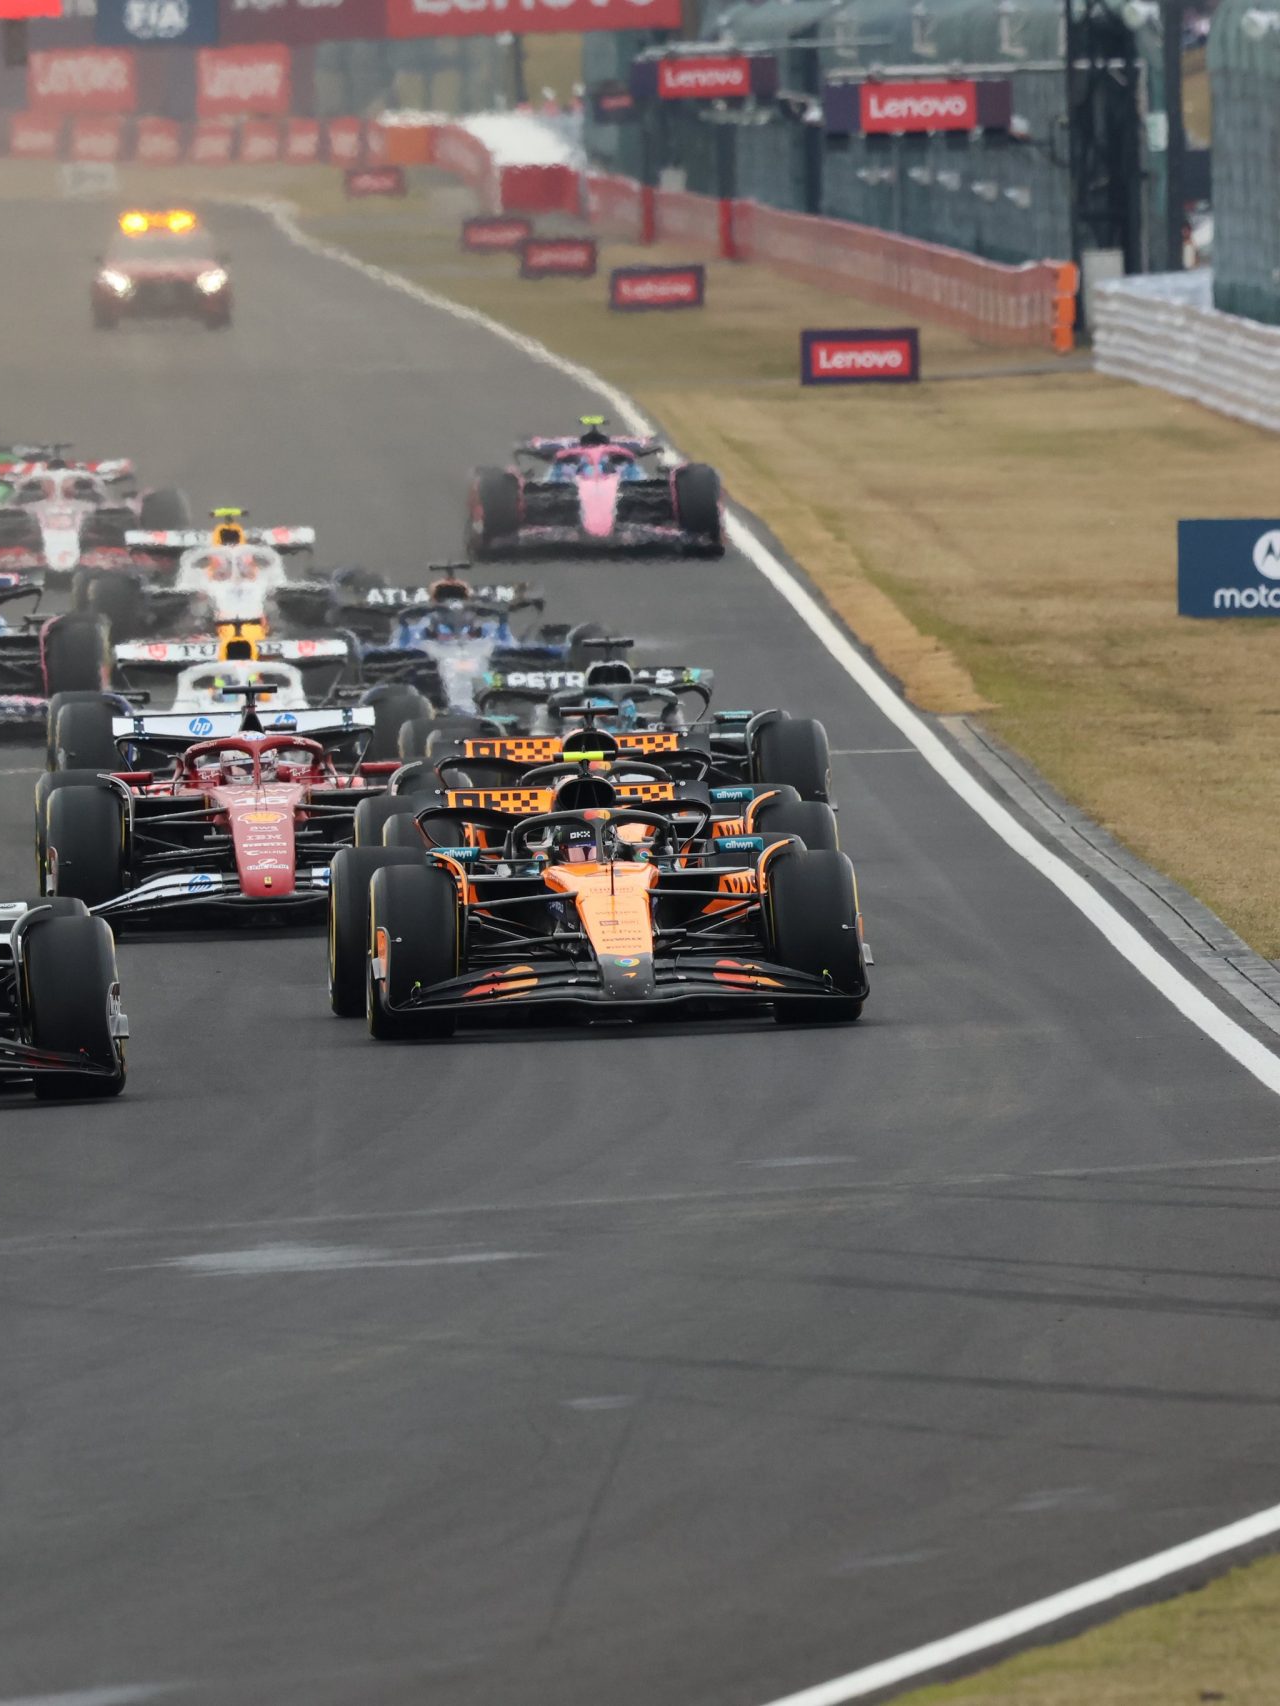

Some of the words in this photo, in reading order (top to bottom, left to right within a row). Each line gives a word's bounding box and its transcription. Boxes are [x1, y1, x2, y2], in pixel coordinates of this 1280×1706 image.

[665, 67, 744, 88] Lenovo
[870, 95, 967, 119] Lenovo
[819, 347, 903, 369] Lenovo
[507, 669, 676, 688] PETRS
[191, 718, 212, 735] hp
[717, 791, 743, 801] allwyn
[570, 831, 591, 840] OKX
[725, 840, 754, 851] allwyn
